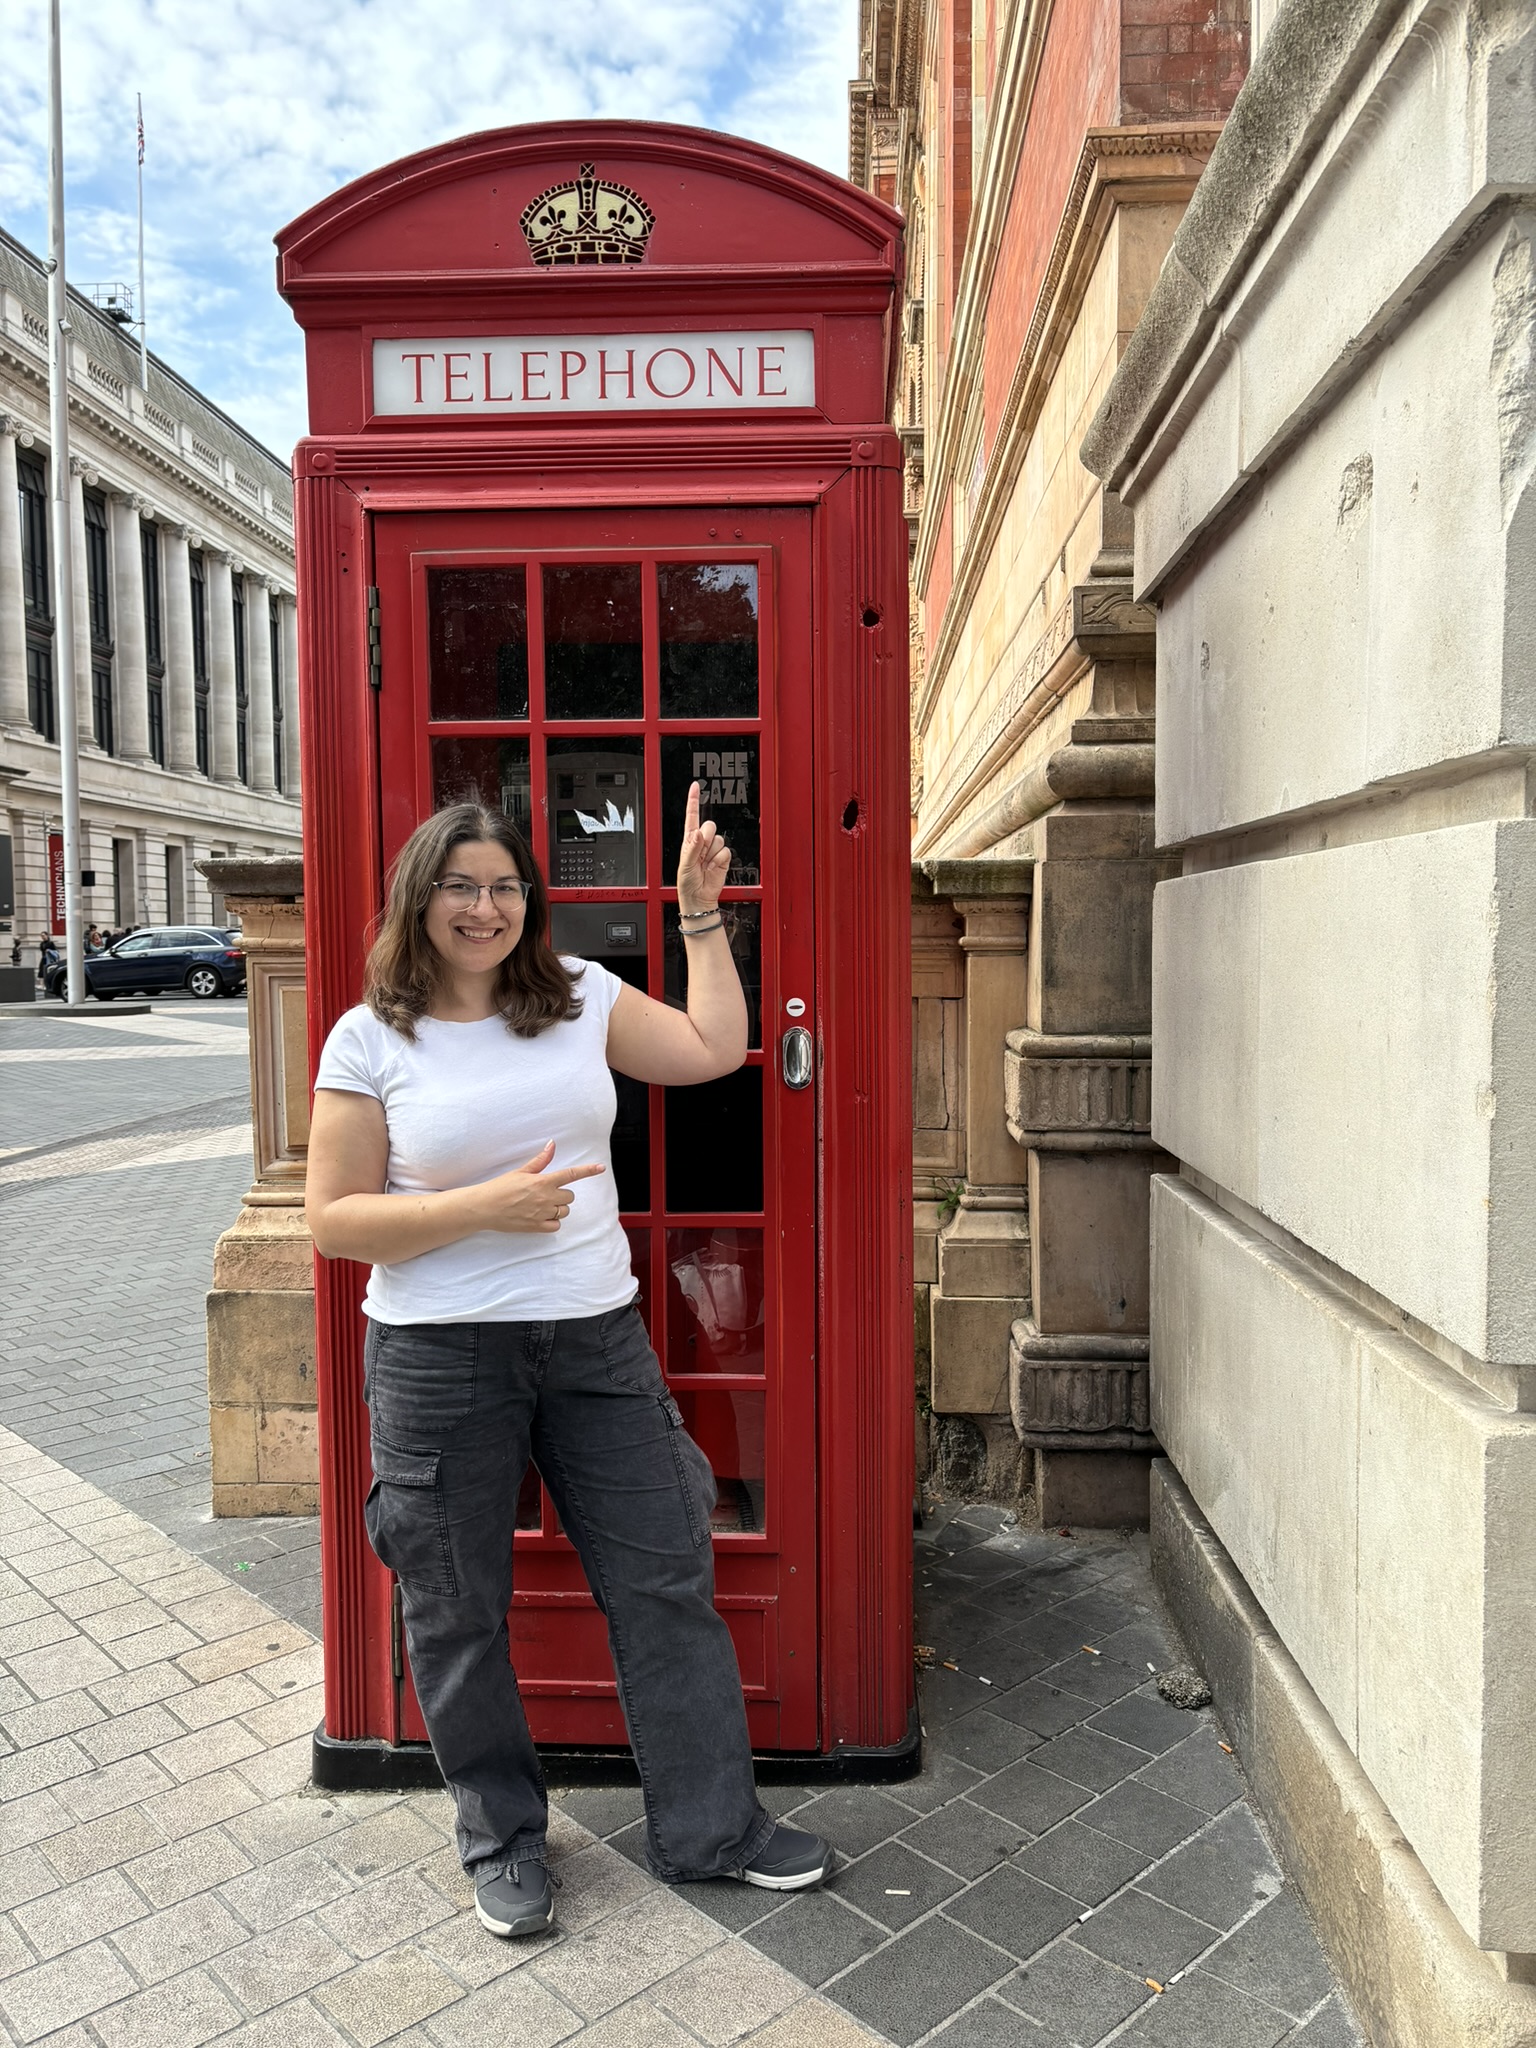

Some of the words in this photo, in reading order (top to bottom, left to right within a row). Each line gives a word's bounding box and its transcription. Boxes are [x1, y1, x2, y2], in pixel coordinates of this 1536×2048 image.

[402, 346, 787, 403] TELEPHONE
[692, 752, 748, 777] FREE
[697, 778, 748, 804] GAZA
[54, 850, 66, 921] TECHNICIANS
